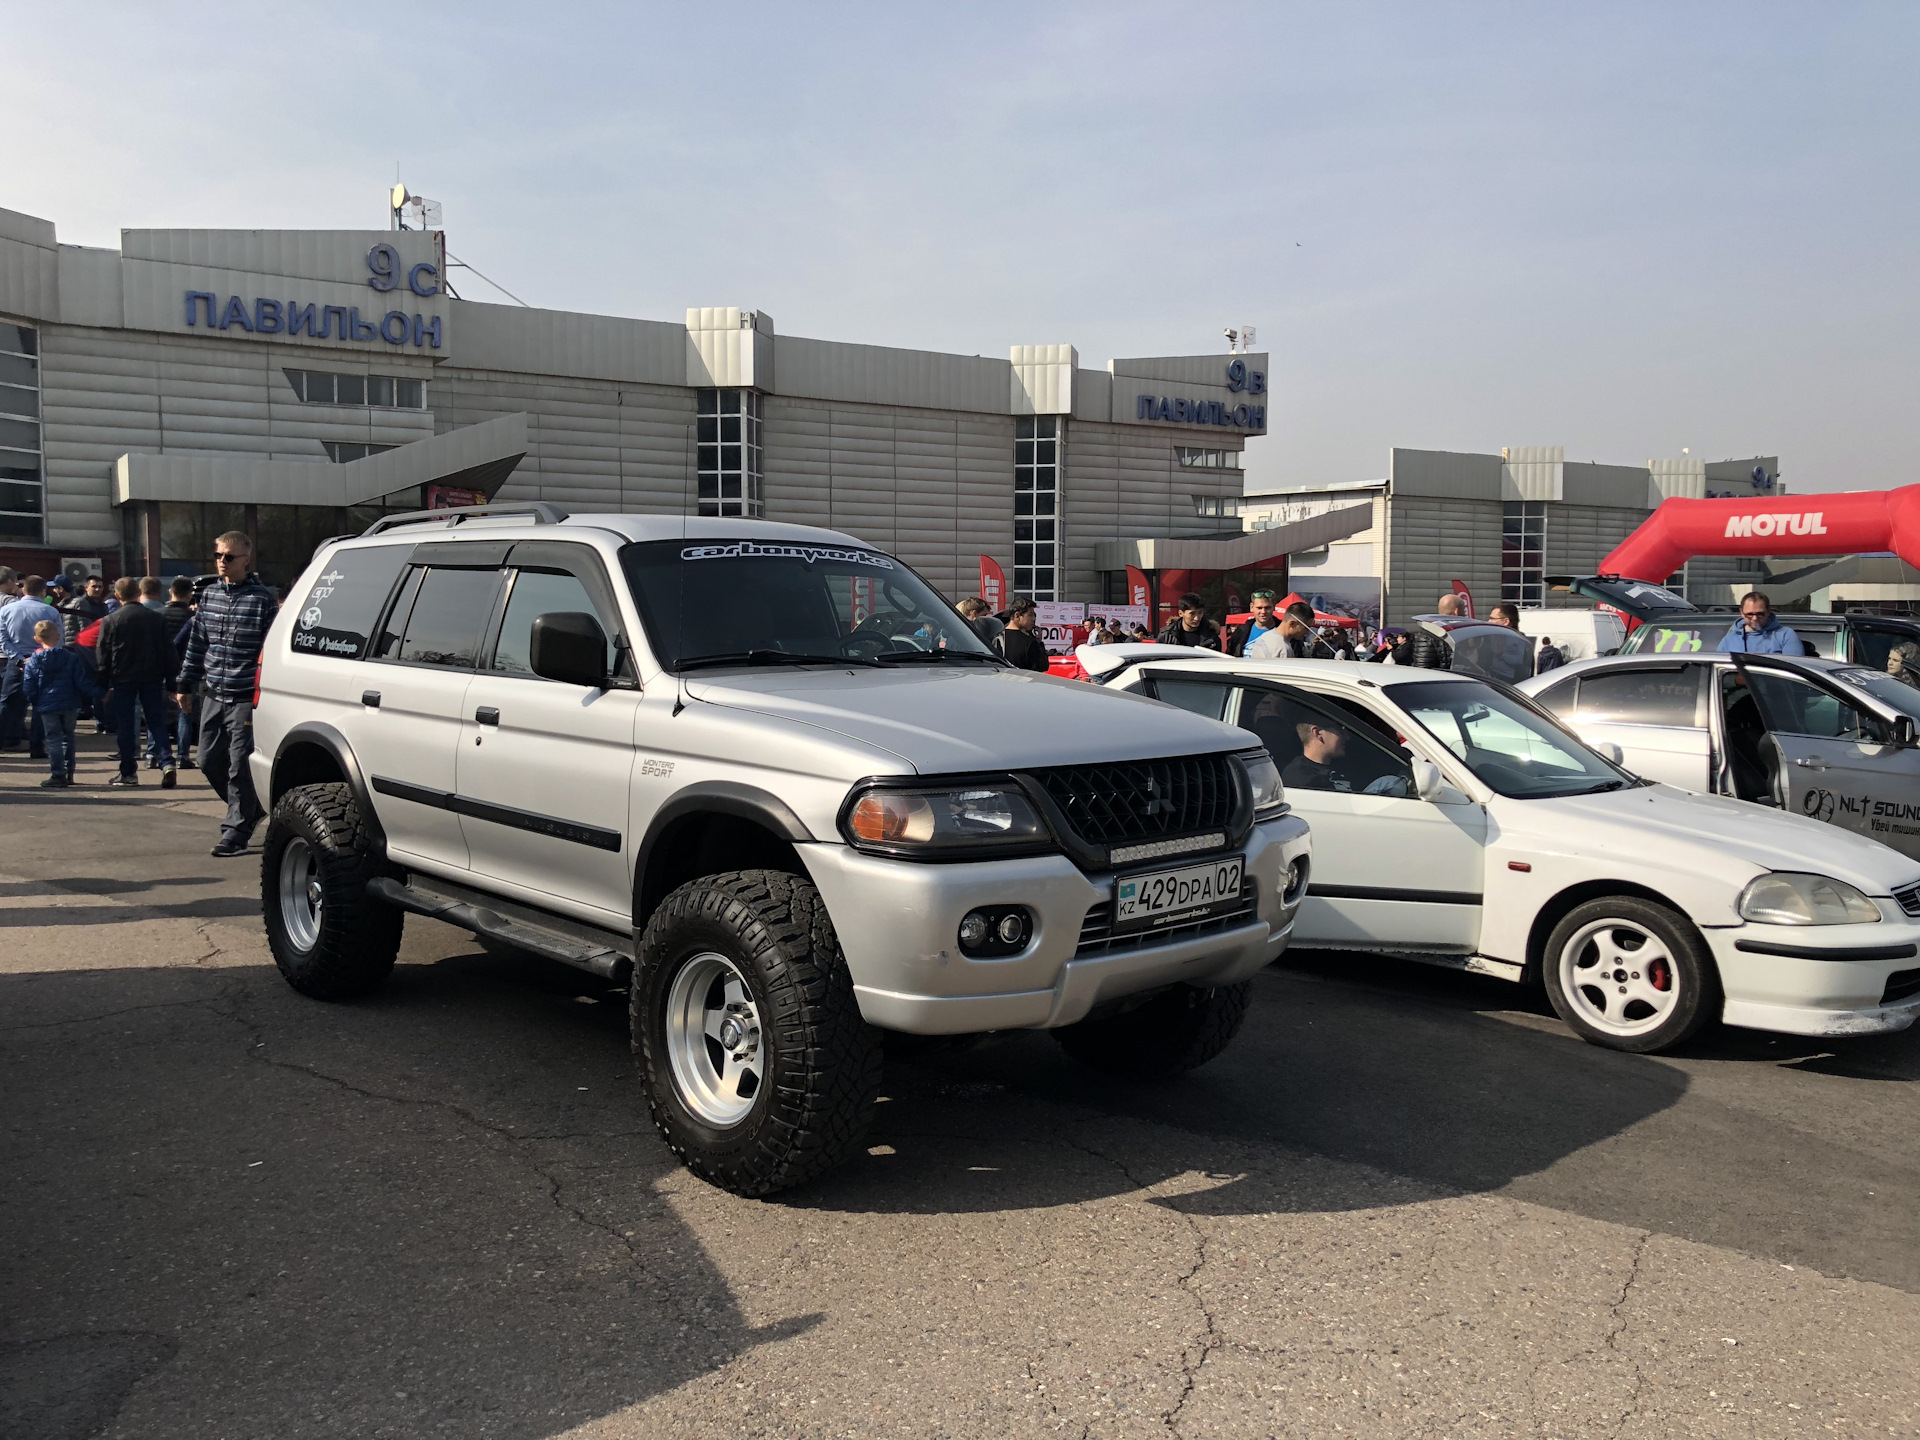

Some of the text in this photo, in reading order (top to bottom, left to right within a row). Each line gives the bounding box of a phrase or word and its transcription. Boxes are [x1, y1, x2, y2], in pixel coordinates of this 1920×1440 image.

[185, 290, 441, 349] ПАВИЛЬОН
[1137, 394, 1265, 429] ПАВИЛЬОН
[1724, 512, 1828, 537] MOTUL
[681, 541, 894, 570] carbonworks
[294, 632, 316, 648] Pride
[643, 758, 675, 769] MONTERO
[641, 766, 673, 778] SPORT
[1892, 824, 1920, 836] тишин
[1119, 901, 1135, 916] KZ
